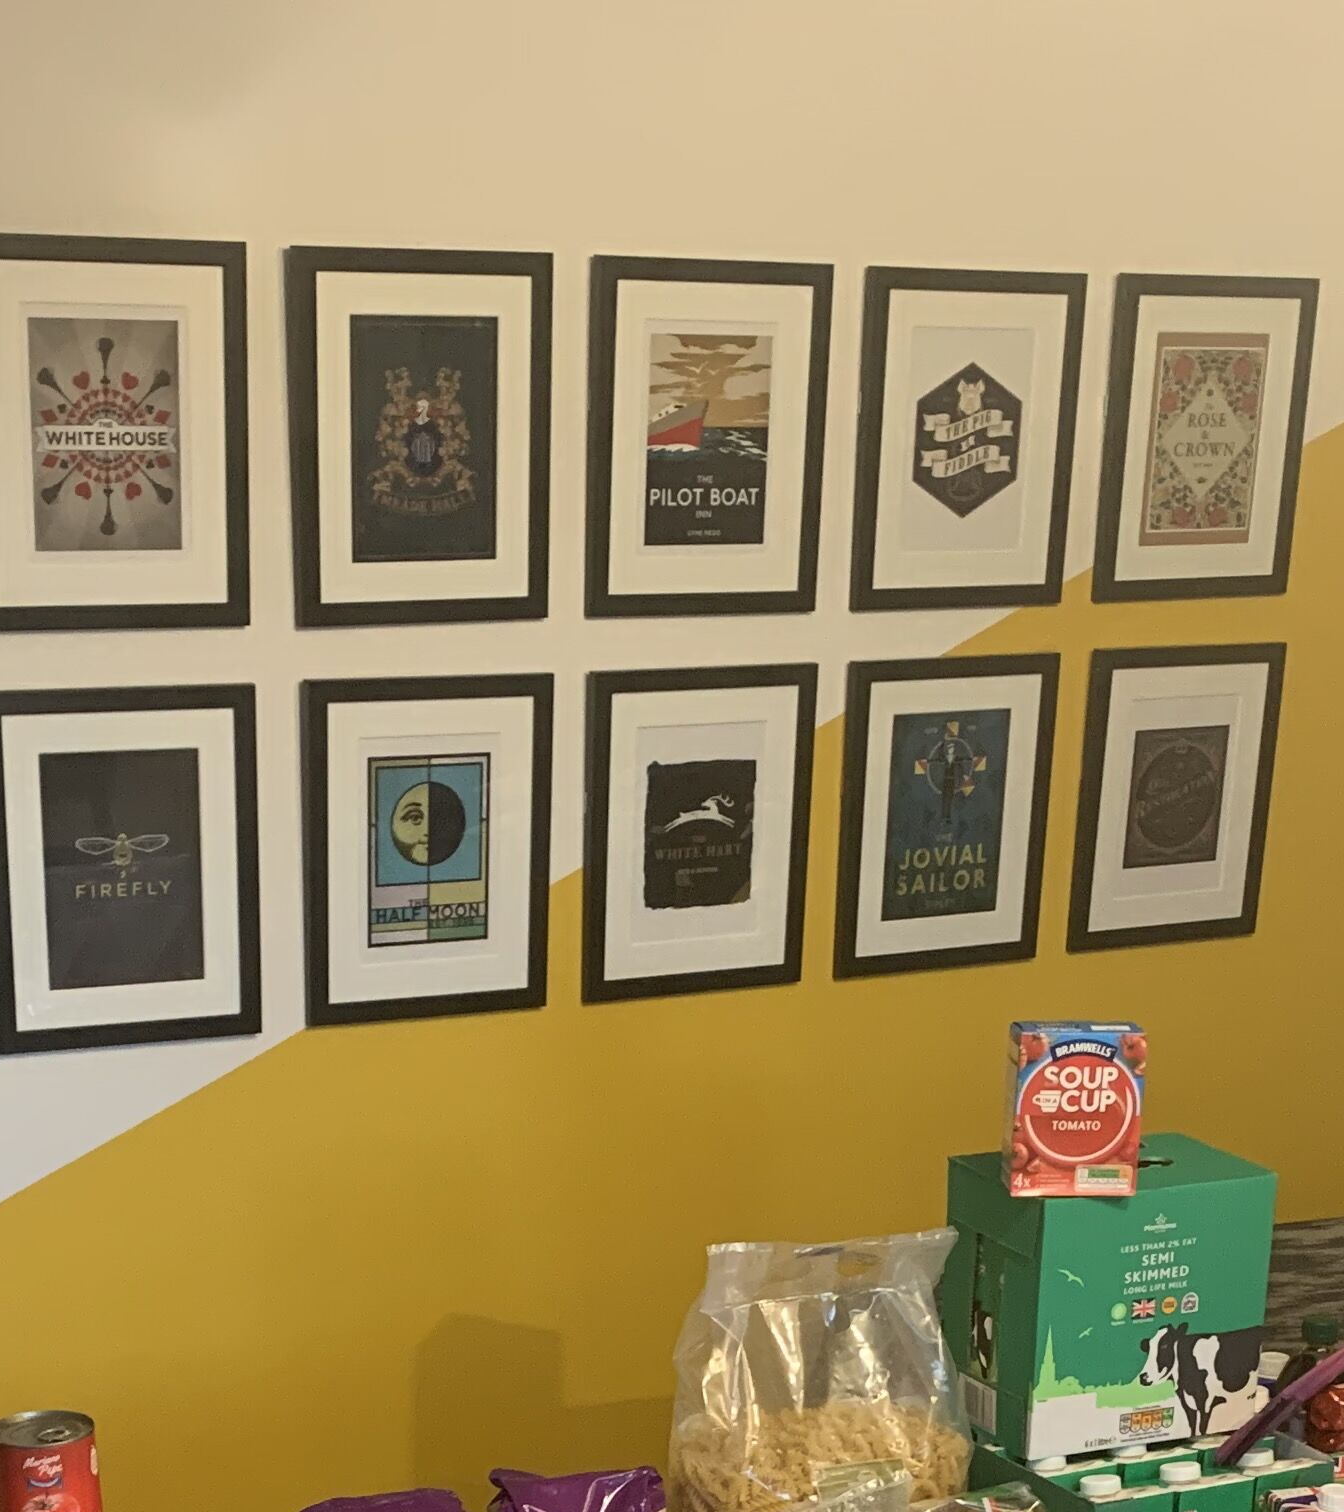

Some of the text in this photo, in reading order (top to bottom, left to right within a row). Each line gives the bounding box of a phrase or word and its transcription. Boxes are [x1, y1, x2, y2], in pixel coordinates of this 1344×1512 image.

[1187, 412, 1227, 428] ROSE
[946, 421, 969, 439] THE
[1173, 441, 1236, 457] CROWN
[945, 446, 991, 475] FIDDLE
[697, 475, 713, 484] THE
[649, 488, 759, 506] PILOT BOAT
[655, 847, 703, 860] WHITE
[898, 843, 987, 870] JOVIAL
[76, 880, 172, 899] FIREFLY
[897, 869, 986, 896] SAILOR
[376, 903, 483, 922] HALF MOON
[1054, 1041, 1114, 1059] BRAMWELLS
[1044, 1066, 1119, 1091] SOUP
[1059, 1089, 1117, 1113] CUP
[1052, 1120, 1102, 1132] TOMATO
[1120, 1243, 1139, 1254] LESS
[1142, 1241, 1166, 1251] THAN
[1182, 1237, 1197, 1246] FAT
[1141, 1251, 1175, 1266] SEMI
[1124, 1265, 1190, 1284] SKIMMED
[1168, 1280, 1188, 1289] MILK
